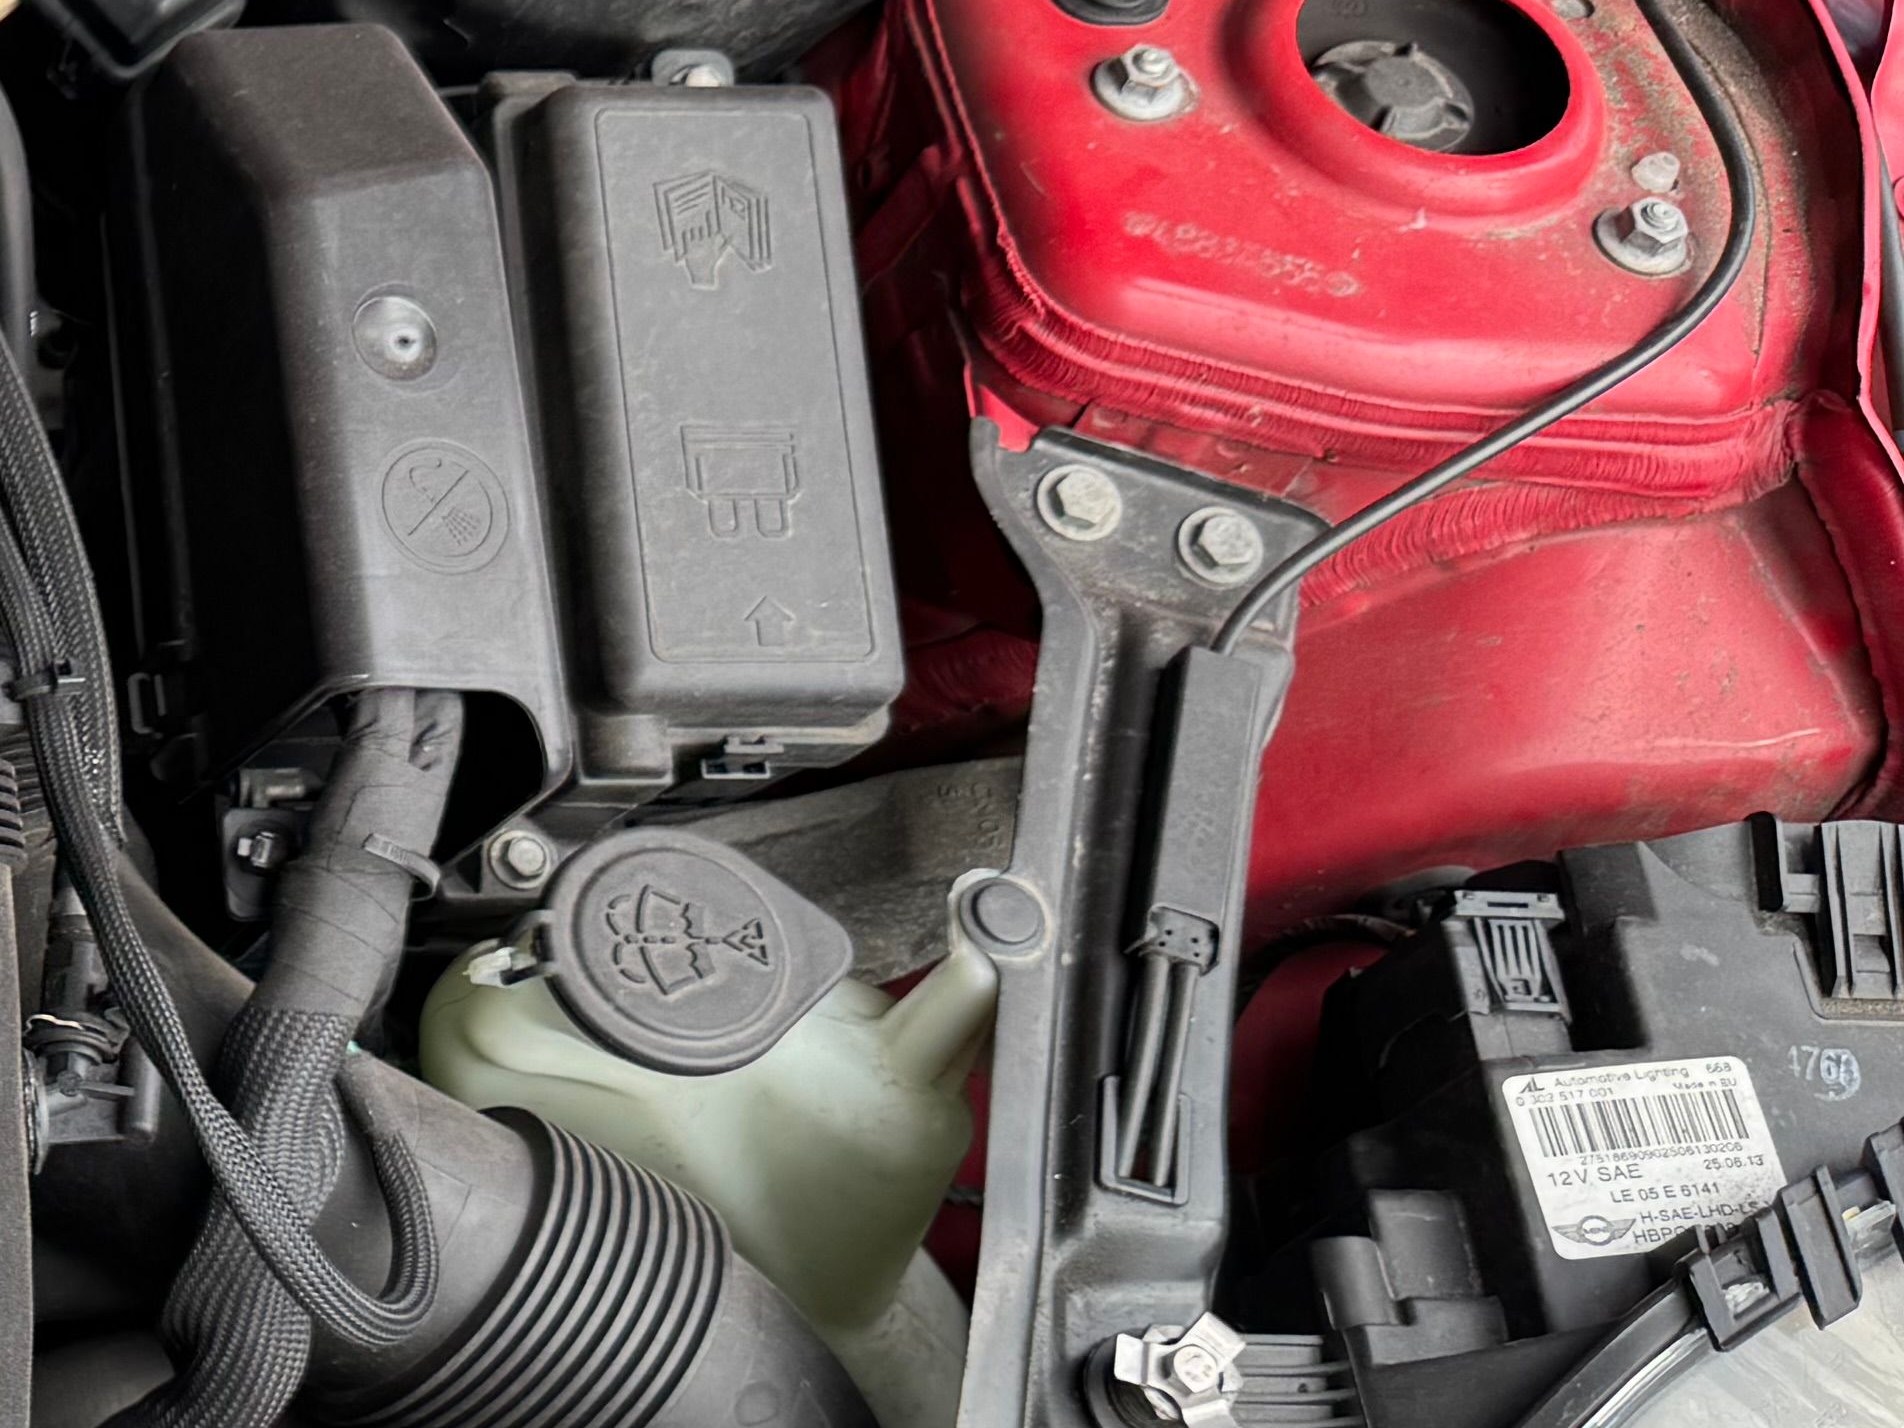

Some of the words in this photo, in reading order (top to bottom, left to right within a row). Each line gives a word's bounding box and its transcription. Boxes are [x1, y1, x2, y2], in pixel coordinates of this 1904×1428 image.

[1554, 1071, 1632, 1088] Automotive
[1635, 1066, 1689, 1082] Lighting
[1719, 1078, 1737, 1088] EU
[1597, 1164, 1643, 1183] SAE
[1611, 1188, 1635, 1204] LE
[1639, 1186, 1660, 1201] 05
[1664, 1185, 1677, 1198] E
[1680, 1182, 1720, 1197] 6141
